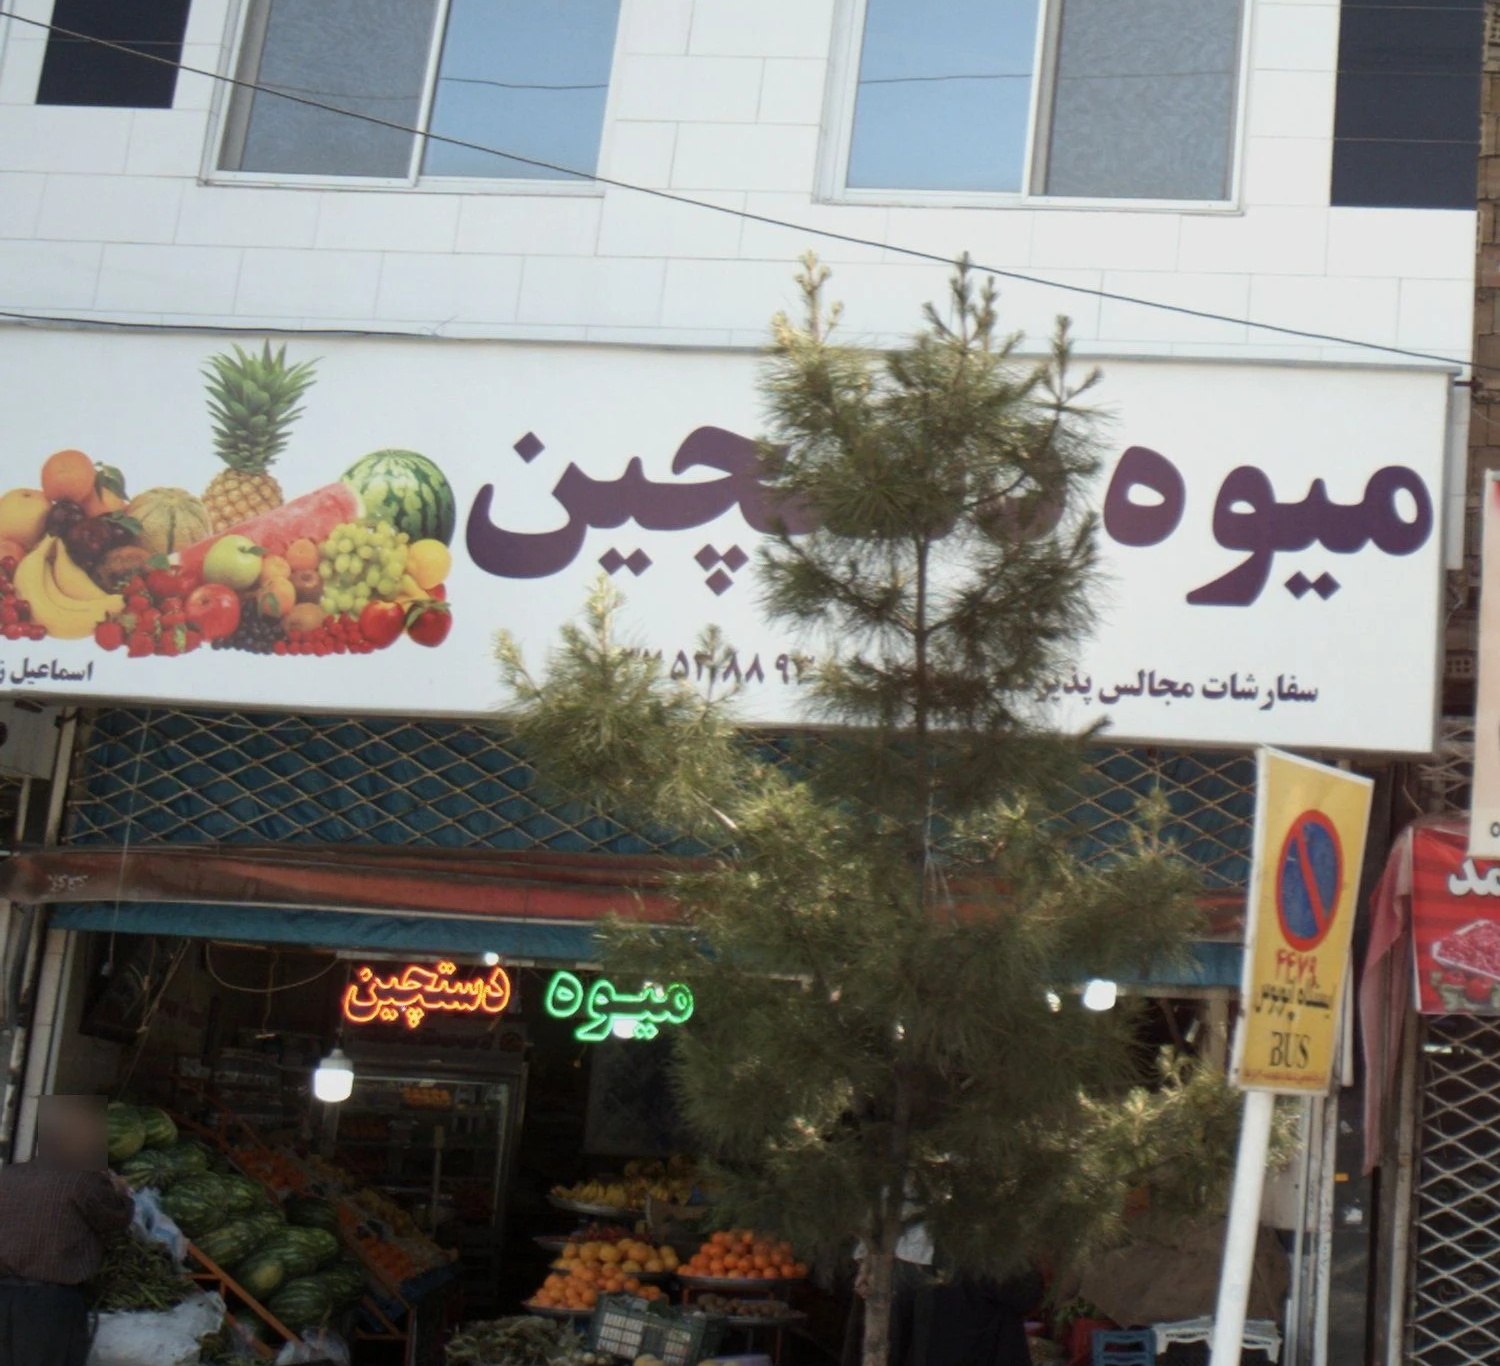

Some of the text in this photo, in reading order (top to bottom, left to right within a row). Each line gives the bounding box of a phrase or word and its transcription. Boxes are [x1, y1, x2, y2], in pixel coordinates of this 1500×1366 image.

[1102, 444, 1434, 607] میوه
[10, 657, 94, 685] اسماعیل
[1098, 667, 1195, 707] مجالس
[1202, 671, 1319, 711] سفارشات
[344, 960, 512, 1030] دستچین
[546, 970, 694, 1041] میوه
[1269, 1030, 1311, 1069] BUS
